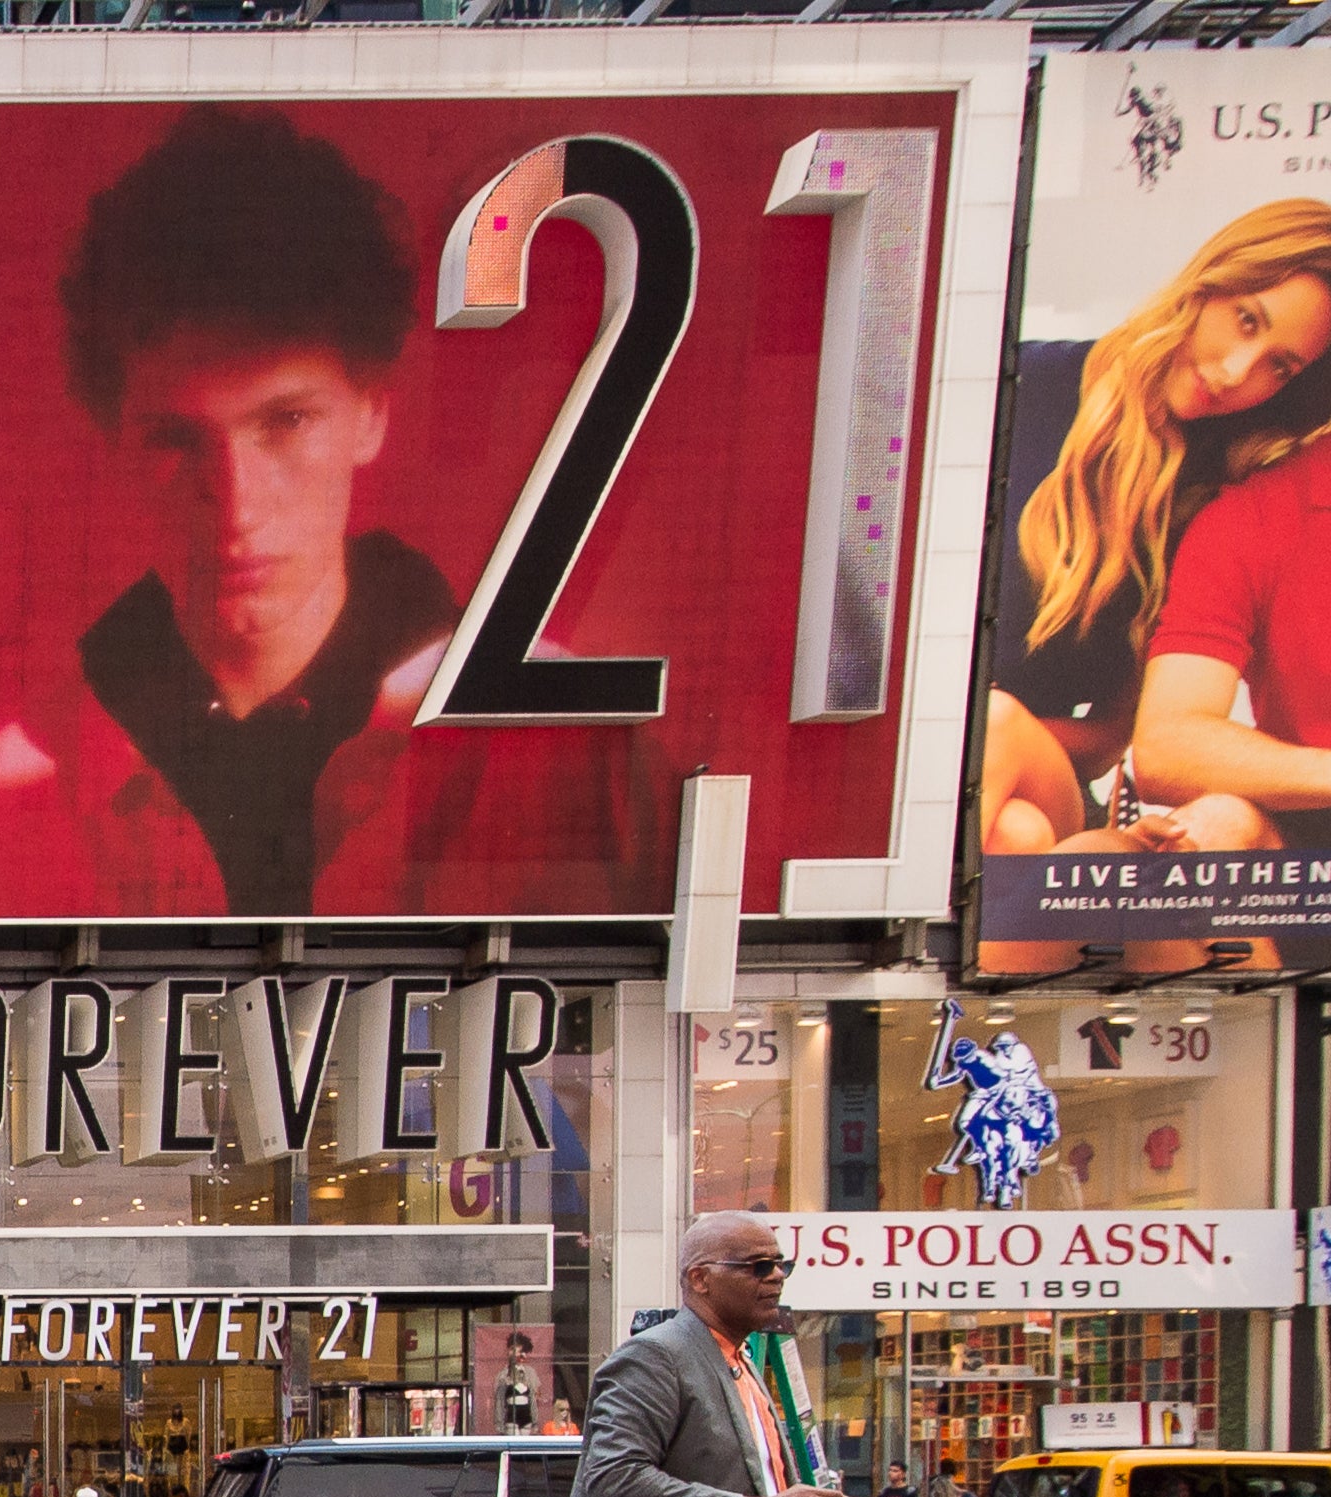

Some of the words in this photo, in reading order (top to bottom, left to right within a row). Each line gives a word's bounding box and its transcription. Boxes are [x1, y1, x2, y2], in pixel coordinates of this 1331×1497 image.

[1212, 104, 1292, 140] U.S.
[412, 130, 939, 727] 21
[1045, 862, 1138, 889] LIVE
[1163, 860, 1331, 888] AUTHEN
[1040, 895, 1111, 910] PAMELA
[1117, 894, 1214, 910] FLANAGAN
[1238, 893, 1299, 908] JONNY
[1211, 912, 1331, 927] USPOLOASSN.CO
[718, 1028, 779, 1067] $25
[1149, 1025, 1211, 1063] $30
[883, 1223, 1043, 1266] POLO
[1060, 1222, 1233, 1265] ASSN.
[872, 1280, 996, 1299] SINCE
[1021, 1279, 1122, 1298] 1890
[0, 1299, 286, 1363] FOREVER
[320, 1297, 379, 1361] 21
[1070, 1413, 1088, 1423] 95
